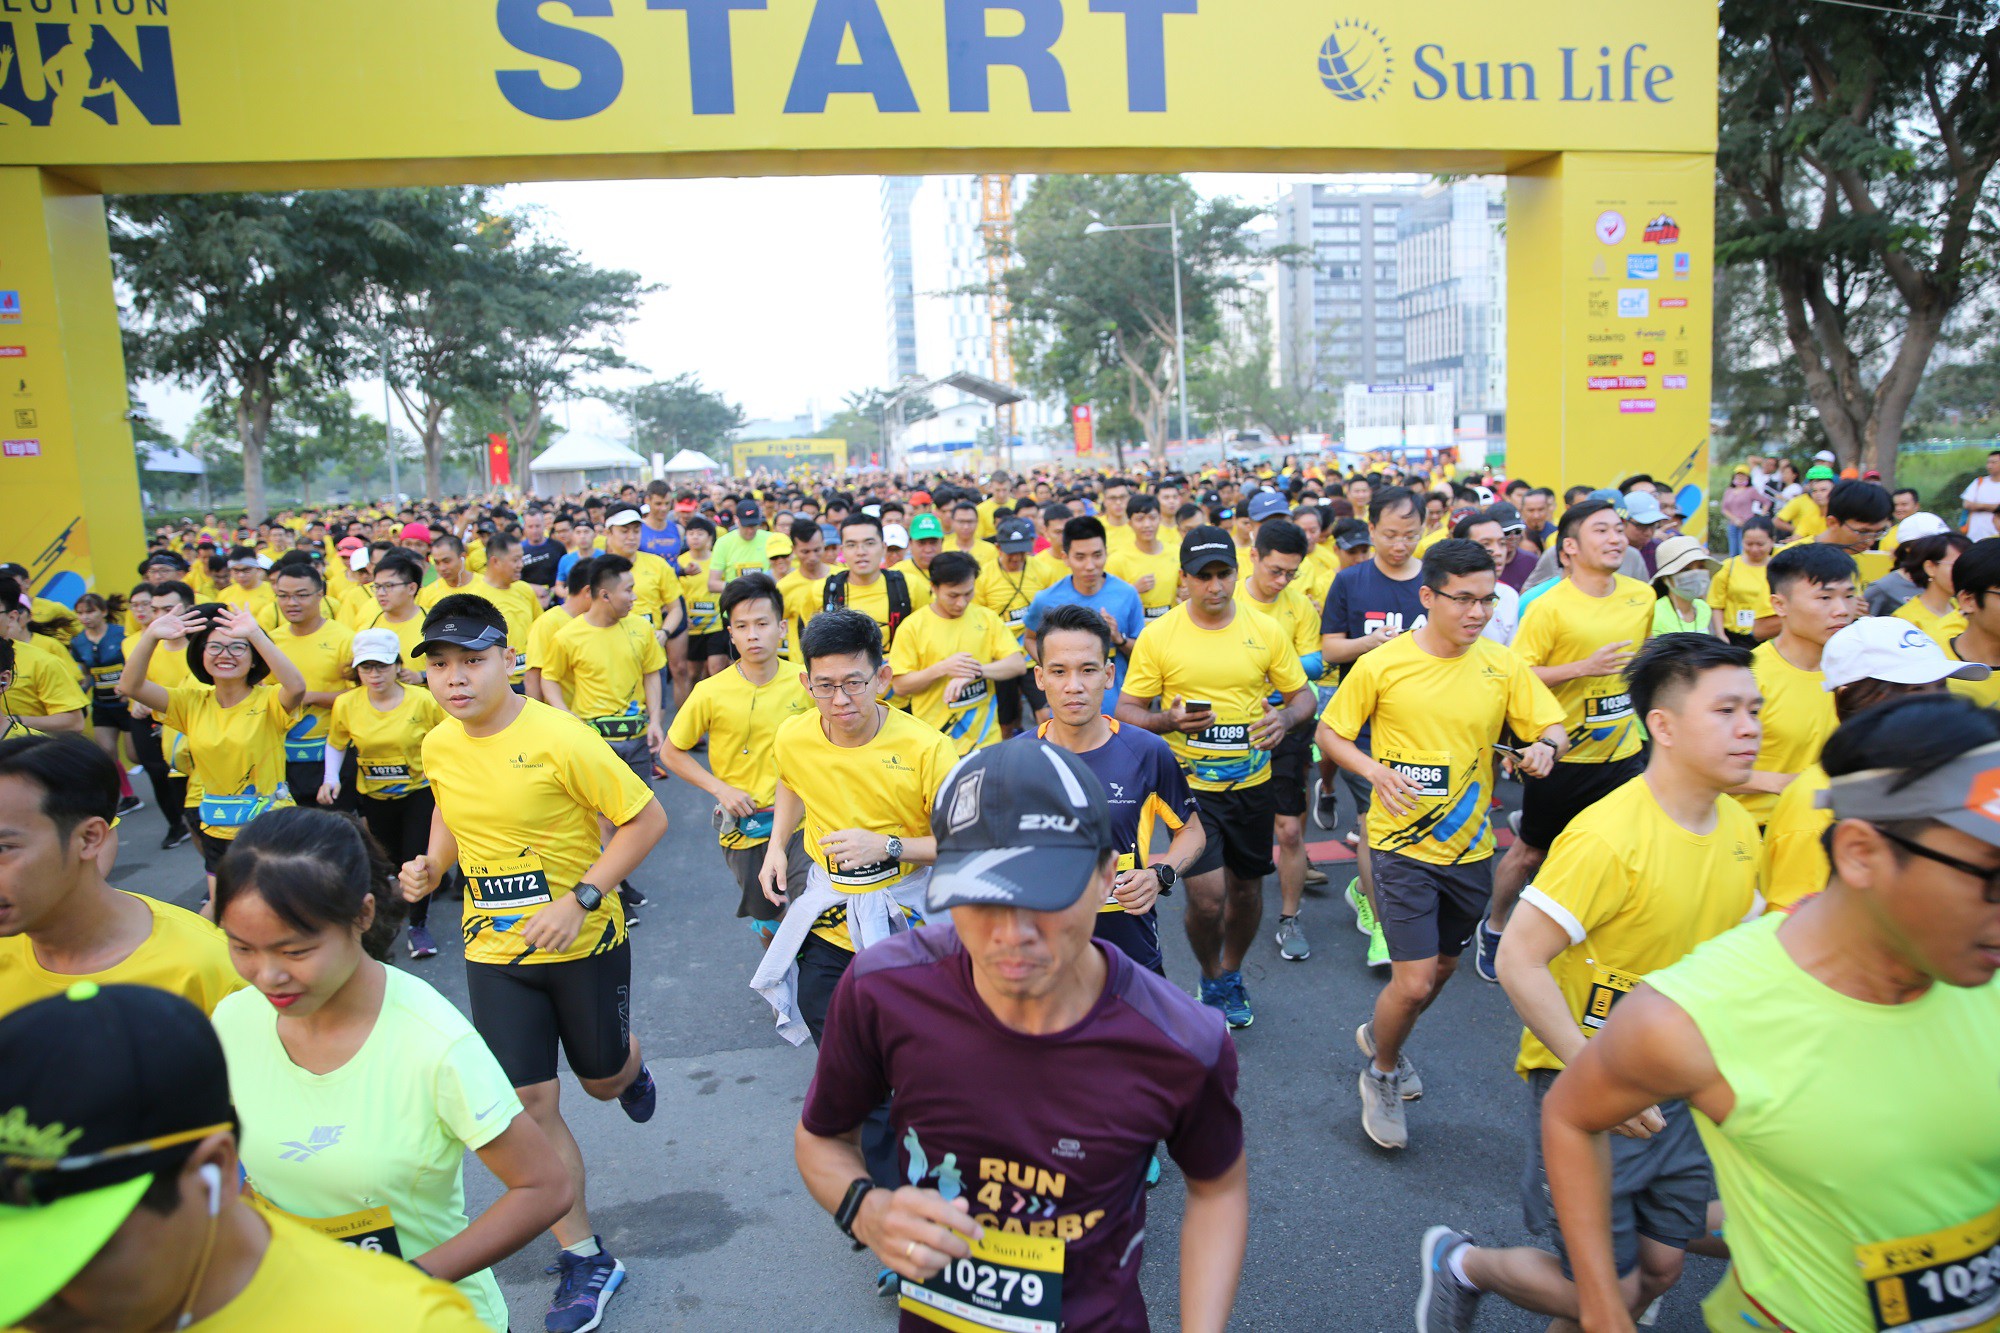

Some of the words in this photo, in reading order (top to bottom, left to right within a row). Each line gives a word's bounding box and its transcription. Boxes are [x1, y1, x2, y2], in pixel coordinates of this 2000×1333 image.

[495, 0, 1197, 120] START
[1413, 43, 1540, 101] Sun
[1557, 42, 1675, 104] Life
[1619, 375, 1647, 388] Times
[767, 443, 812, 452] FINISH
[1205, 725, 1245, 739] 11089
[1394, 763, 1442, 783] 10686
[1018, 813, 1080, 833] 2XU
[484, 874, 540, 895] 11772
[308, 1124, 346, 1144] NIKE
[979, 1157, 1066, 1199] RUN
[976, 1181, 1003, 1212] 4
[324, 1221, 349, 1235] Sun
[351, 1218, 373, 1231] Life
[993, 1244, 1017, 1257] Sun
[1020, 1247, 1043, 1262] Life
[944, 1258, 1044, 1307] 10279
